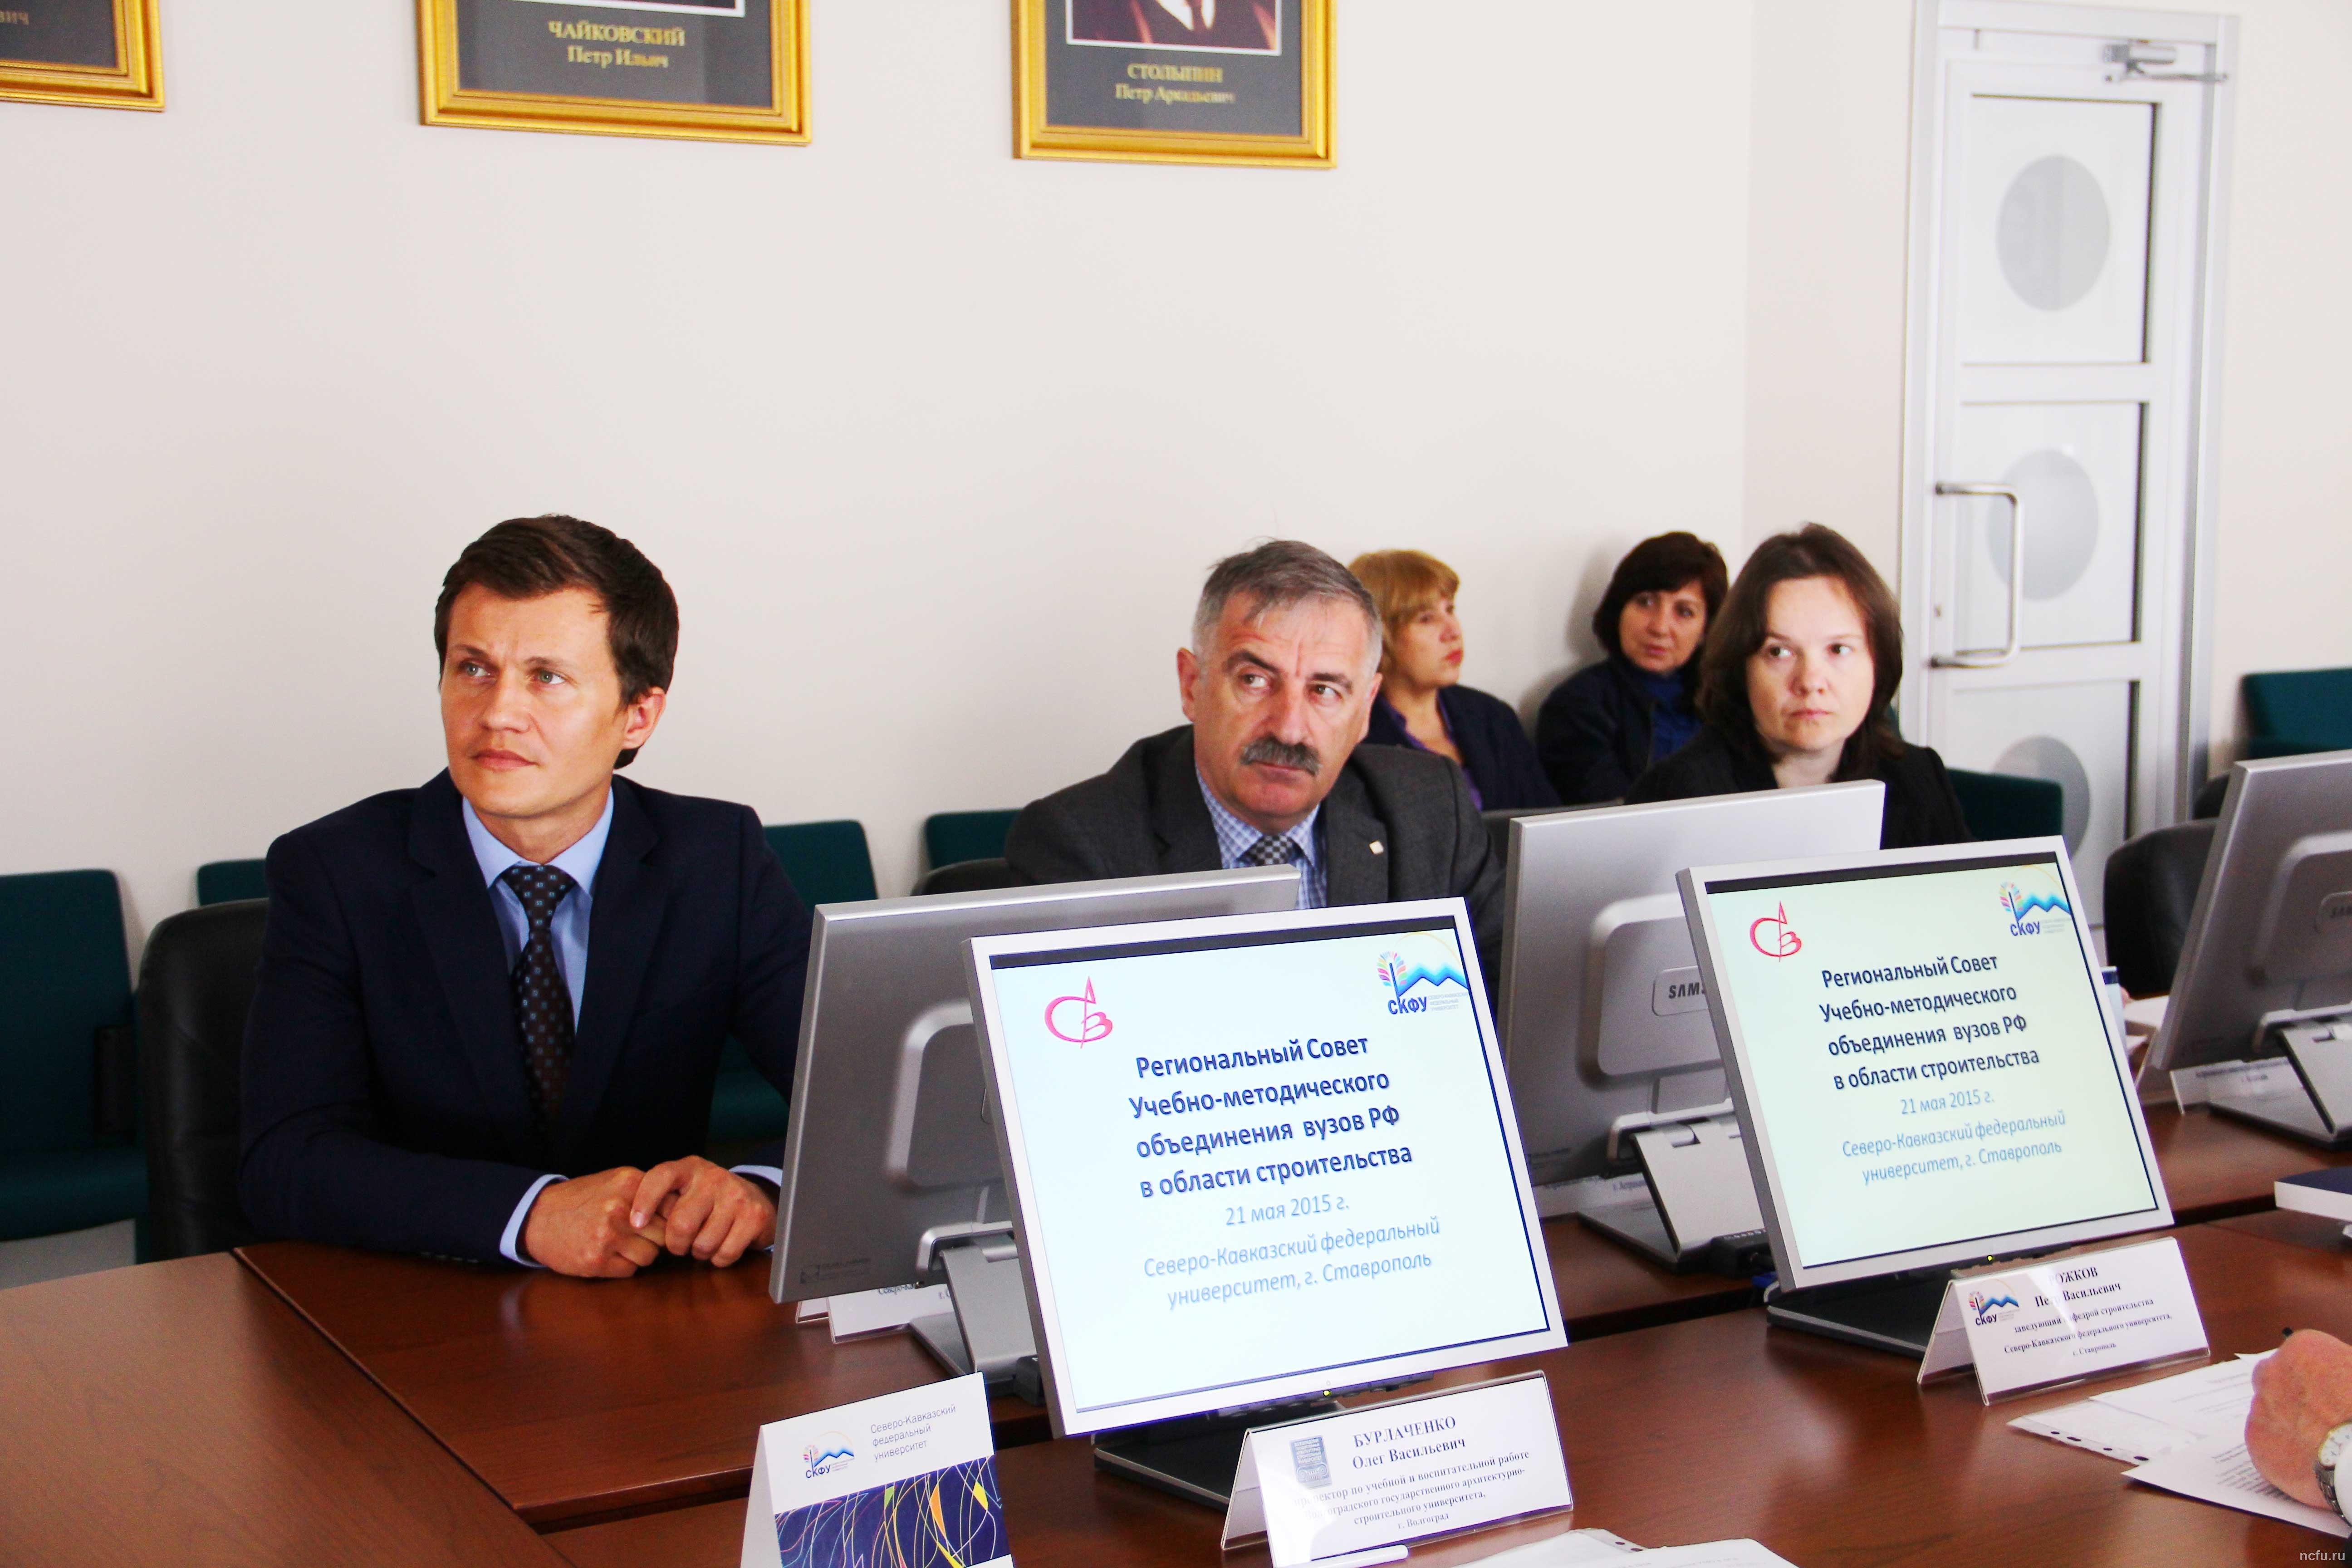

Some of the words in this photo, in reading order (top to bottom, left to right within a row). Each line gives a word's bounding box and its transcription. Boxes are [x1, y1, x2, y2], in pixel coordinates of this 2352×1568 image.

[549, 20, 686, 46] ЧАЙКОВСКИЙ
[568, 45, 612, 69] Петр
[2010, 921, 2040, 936] СКФУ
[1822, 957, 1948, 987] Региональный
[1951, 955, 1998, 974] Совет
[1388, 996, 1427, 1014] СКФУ
[1669, 982, 1705, 999] SAM
[1819, 986, 2017, 1022] Учебно-методического
[1828, 1025, 1945, 1056] объединения
[1954, 1019, 2000, 1042] вузов
[2003, 1015, 2027, 1034] РФ
[1136, 1039, 1303, 1078] Региональный
[1307, 1036, 1368, 1059] Совет
[1834, 1075, 1844, 1089] в
[1849, 1065, 1916, 1087] области
[1921, 1049, 2039, 1079] строительства
[1129, 1071, 1390, 1119] Учебно-методического
[1901, 1099, 1916, 1114] 21
[1920, 1098, 1945, 1112] мая
[1950, 1090, 1981, 1107] 2015
[1984, 1090, 1994, 1103] г.
[1137, 1121, 1293, 1158] объединения
[1303, 1112, 1364, 1140] вузов
[1369, 1105, 1400, 1128] РФ
[1842, 1123, 1973, 1156] Северо-Кавказский
[1975, 1111, 2066, 1139] федеральный
[1141, 1180, 1153, 1198] в
[1159, 1166, 1250, 1195] области
[1256, 1146, 1412, 1184] строительства
[1862, 1156, 1963, 1185] университет,
[1965, 1155, 1975, 1166] г.
[1979, 1141, 2062, 1164] Ставрополь
[1225, 1206, 1245, 1225] 21
[1251, 1203, 1284, 1221] мая
[1290, 1194, 1331, 1215] 2015
[1337, 1196, 1349, 1210] г.
[1144, 1234, 1317, 1277] Северо-Кавказский
[1321, 1216, 1440, 1254] федеральный
[1167, 1274, 1300, 1311] университет,
[1304, 1271, 1318, 1285] г.
[1323, 1254, 1431, 1283] Ставрополь
[2035, 1295, 2062, 1307] Пер
[2063, 1283, 2121, 1301] Васильевич
[1975, 1314, 1996, 1325] СКФУ
[2101, 1298, 2153, 1315] строительства
[2004, 1333, 2075, 1353] Северо-Кавказского
[2078, 1324, 2124, 1339] федерального
[871, 1404, 956, 1433] Северо-Кавказский
[1354, 1416, 1456, 1448] БУРЛАЧЕНКО
[872, 1424, 931, 1447] федеральный
[874, 1440, 927, 1462] университет
[1352, 1453, 1385, 1470] Олег
[1389, 1438, 1465, 1463] Васильевич
[806, 1465, 831, 1478] СКФУ
[1351, 1486, 1362, 1495] по
[1367, 1475, 1406, 1494] учебной
[1418, 1456, 1495, 1481] воспитательной
[1498, 1451, 1529, 1466] работе
[1304, 1499, 1378, 1519] Волоградского
[1381, 1482, 1460, 1503] государственного
[1463, 1468, 1525, 1487] архитектурно-
[1354, 1505, 1421, 1525] строительного
[1424, 1491, 1485, 1511] университета,
[1407, 1512, 1449, 1527] Волгоград
